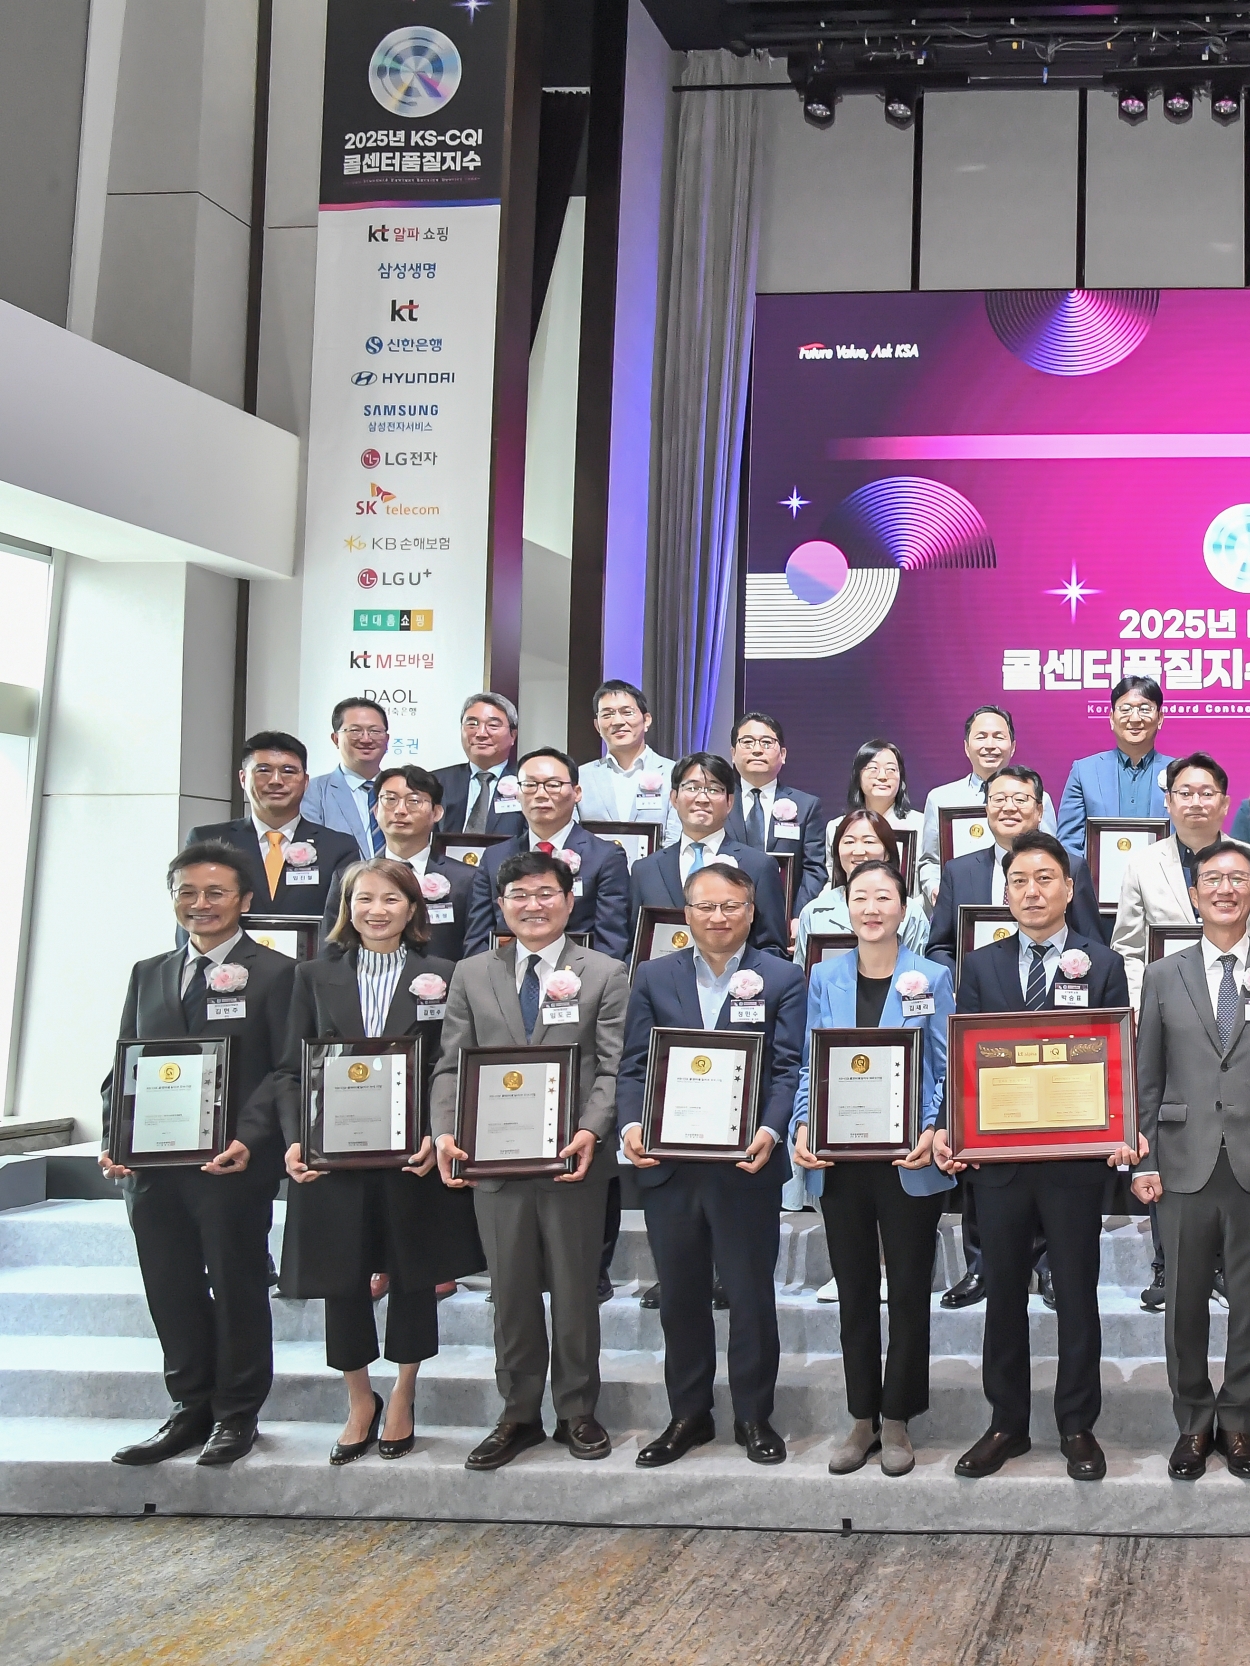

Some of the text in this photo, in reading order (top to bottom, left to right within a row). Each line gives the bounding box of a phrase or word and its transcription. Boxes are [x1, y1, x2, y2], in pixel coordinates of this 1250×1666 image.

[344, 129, 482, 149] 2025년 KS-CQI
[343, 151, 482, 174] 콜센터품질지수
[368, 224, 389, 242] kt
[378, 262, 436, 280] 삼성생명
[390, 300, 419, 322] kt
[387, 338, 442, 352] 신한은행
[382, 372, 455, 384] HYUNDAI
[364, 404, 438, 416] SAMSUNG
[368, 422, 433, 432] 삼성전자서비스
[356, 500, 440, 516] SK telecom
[382, 572, 405, 586] LG
[1119, 608, 1237, 640] 2025년
[350, 650, 372, 669] kt
[364, 689, 418, 703] DAOL
[1162, 704, 1199, 714] ndard
[387, 738, 418, 755] 증권
